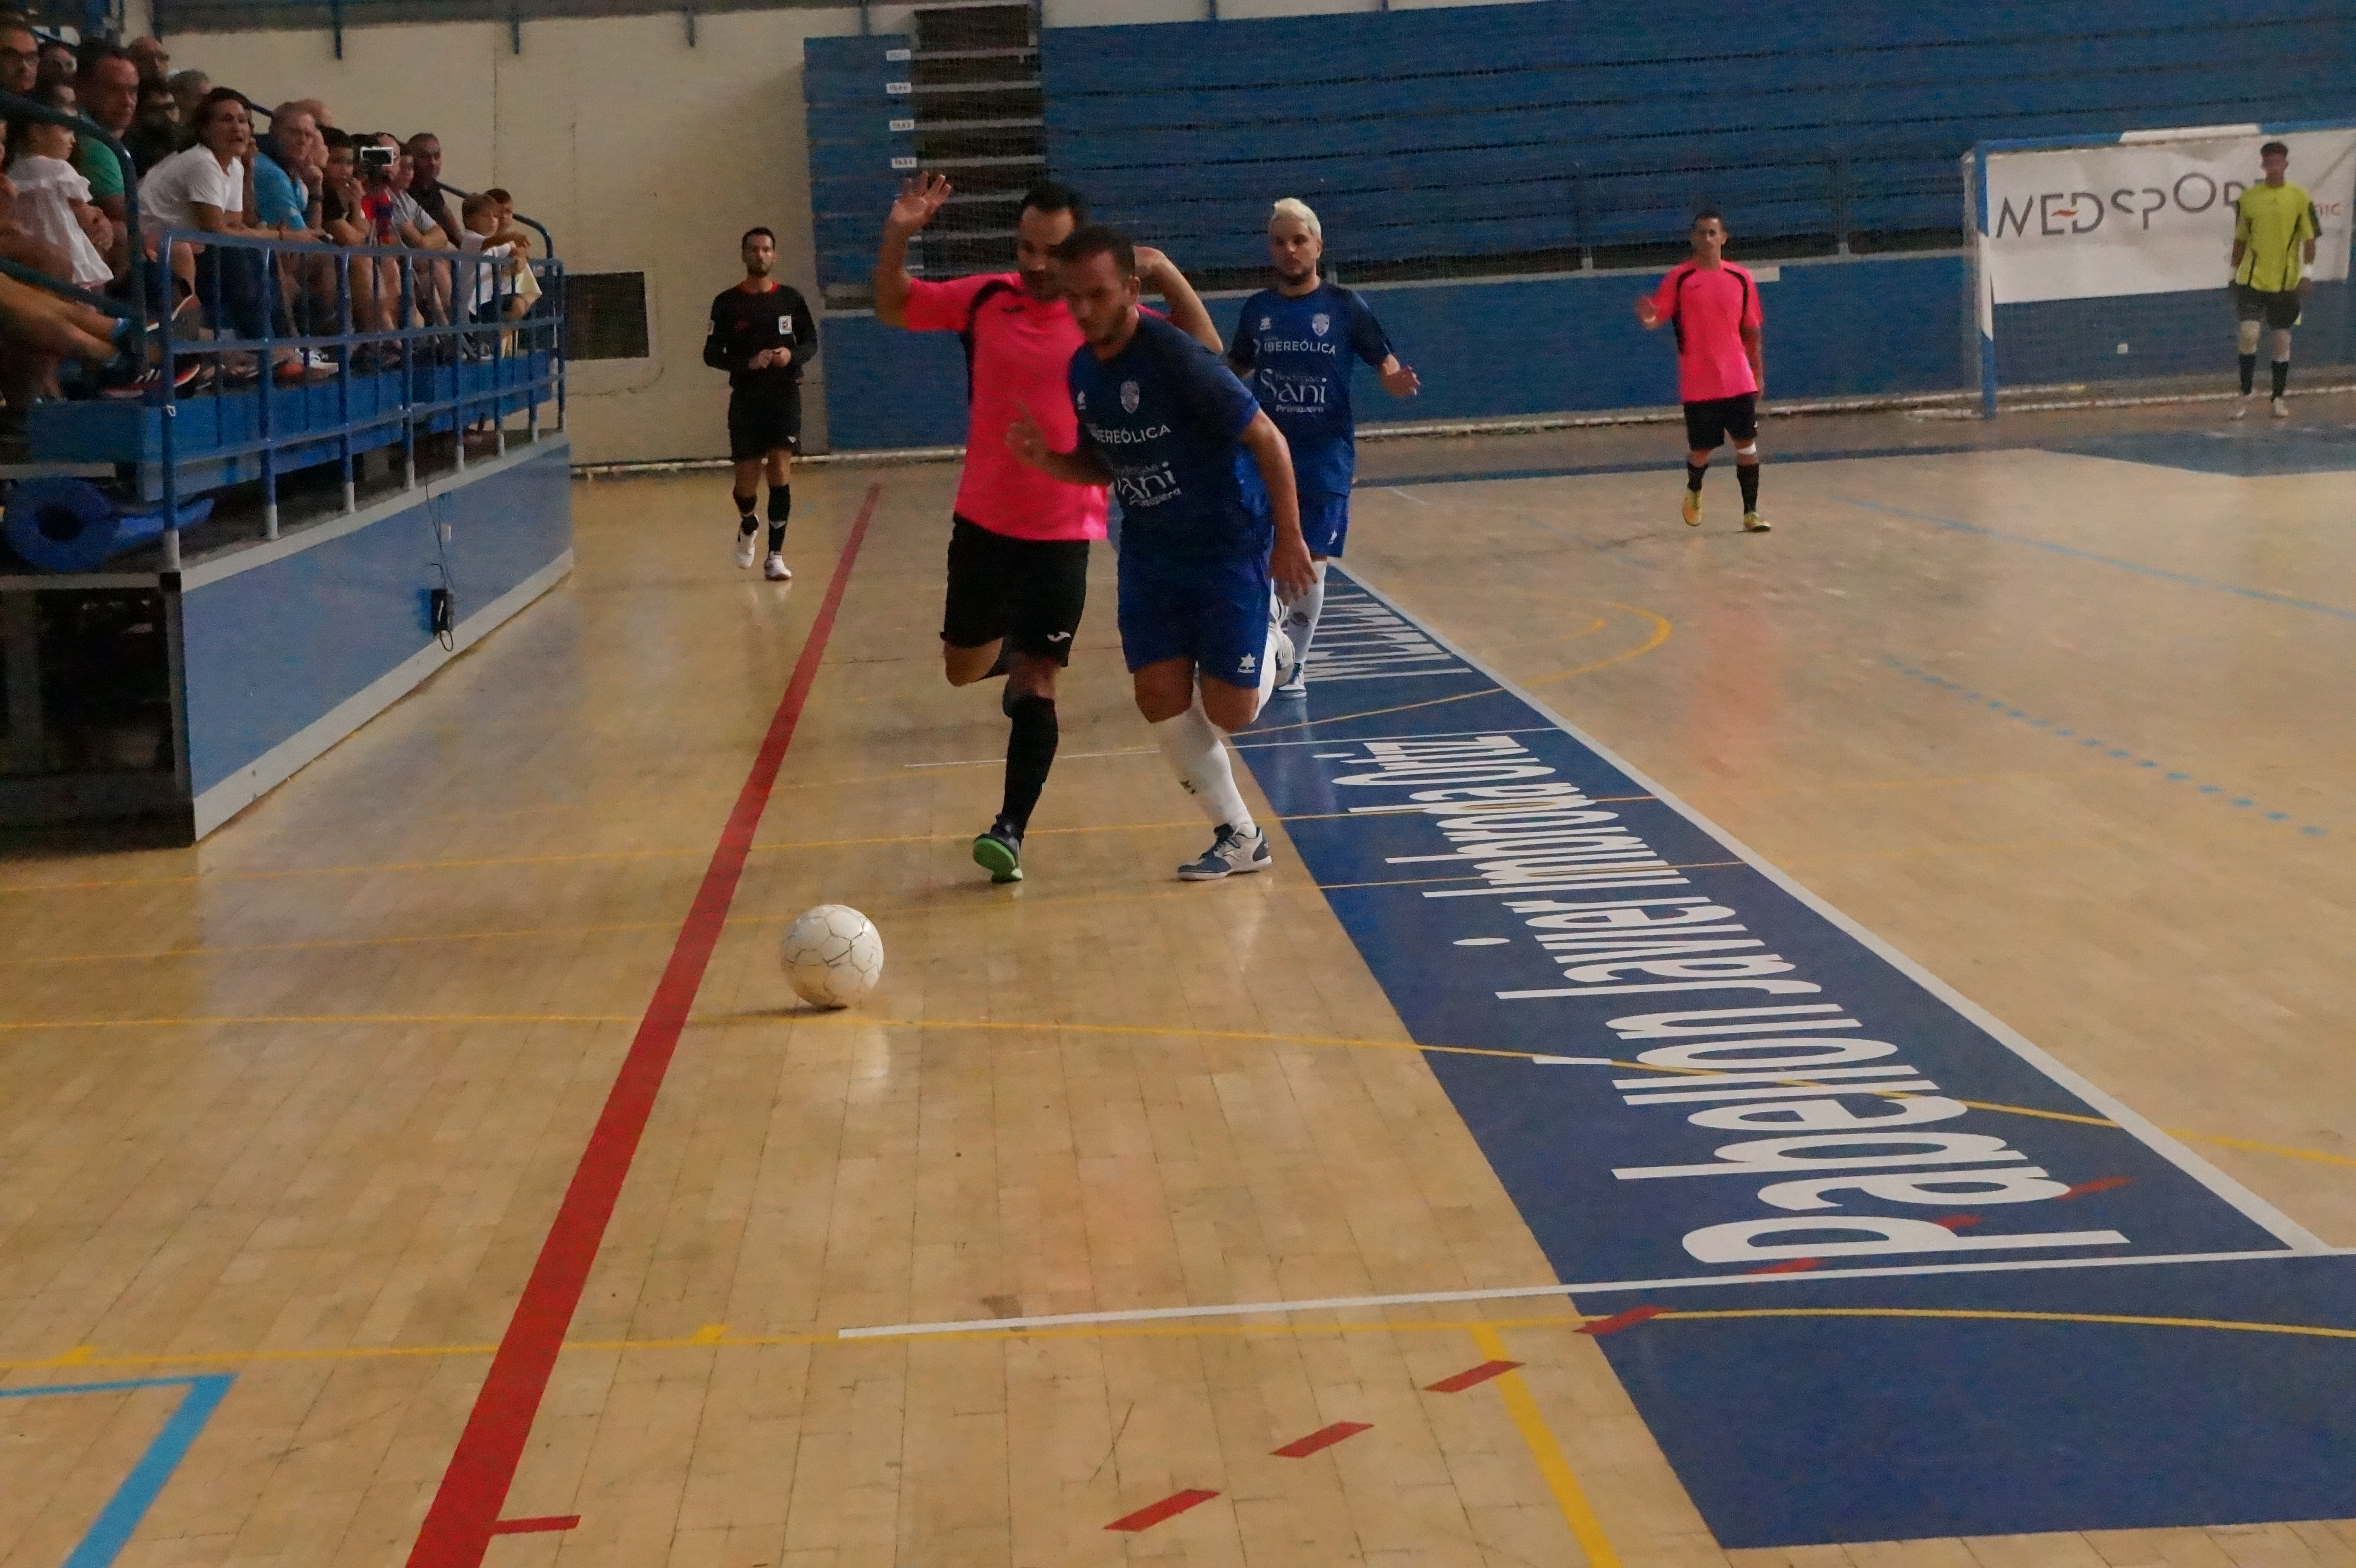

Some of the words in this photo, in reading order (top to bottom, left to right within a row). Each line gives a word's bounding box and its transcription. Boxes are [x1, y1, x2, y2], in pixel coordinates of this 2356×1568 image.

[1996, 172, 2265, 238] MEDSPO
[1264, 339, 1336, 355] IBEREÓLICA
[1260, 368, 1327, 402] Sani
[1312, 735, 1557, 786] Ortiz
[1348, 782, 1691, 898] Imbroda
[1453, 896, 1822, 999] Javier
[1533, 1003, 2131, 1264] Pabellón
